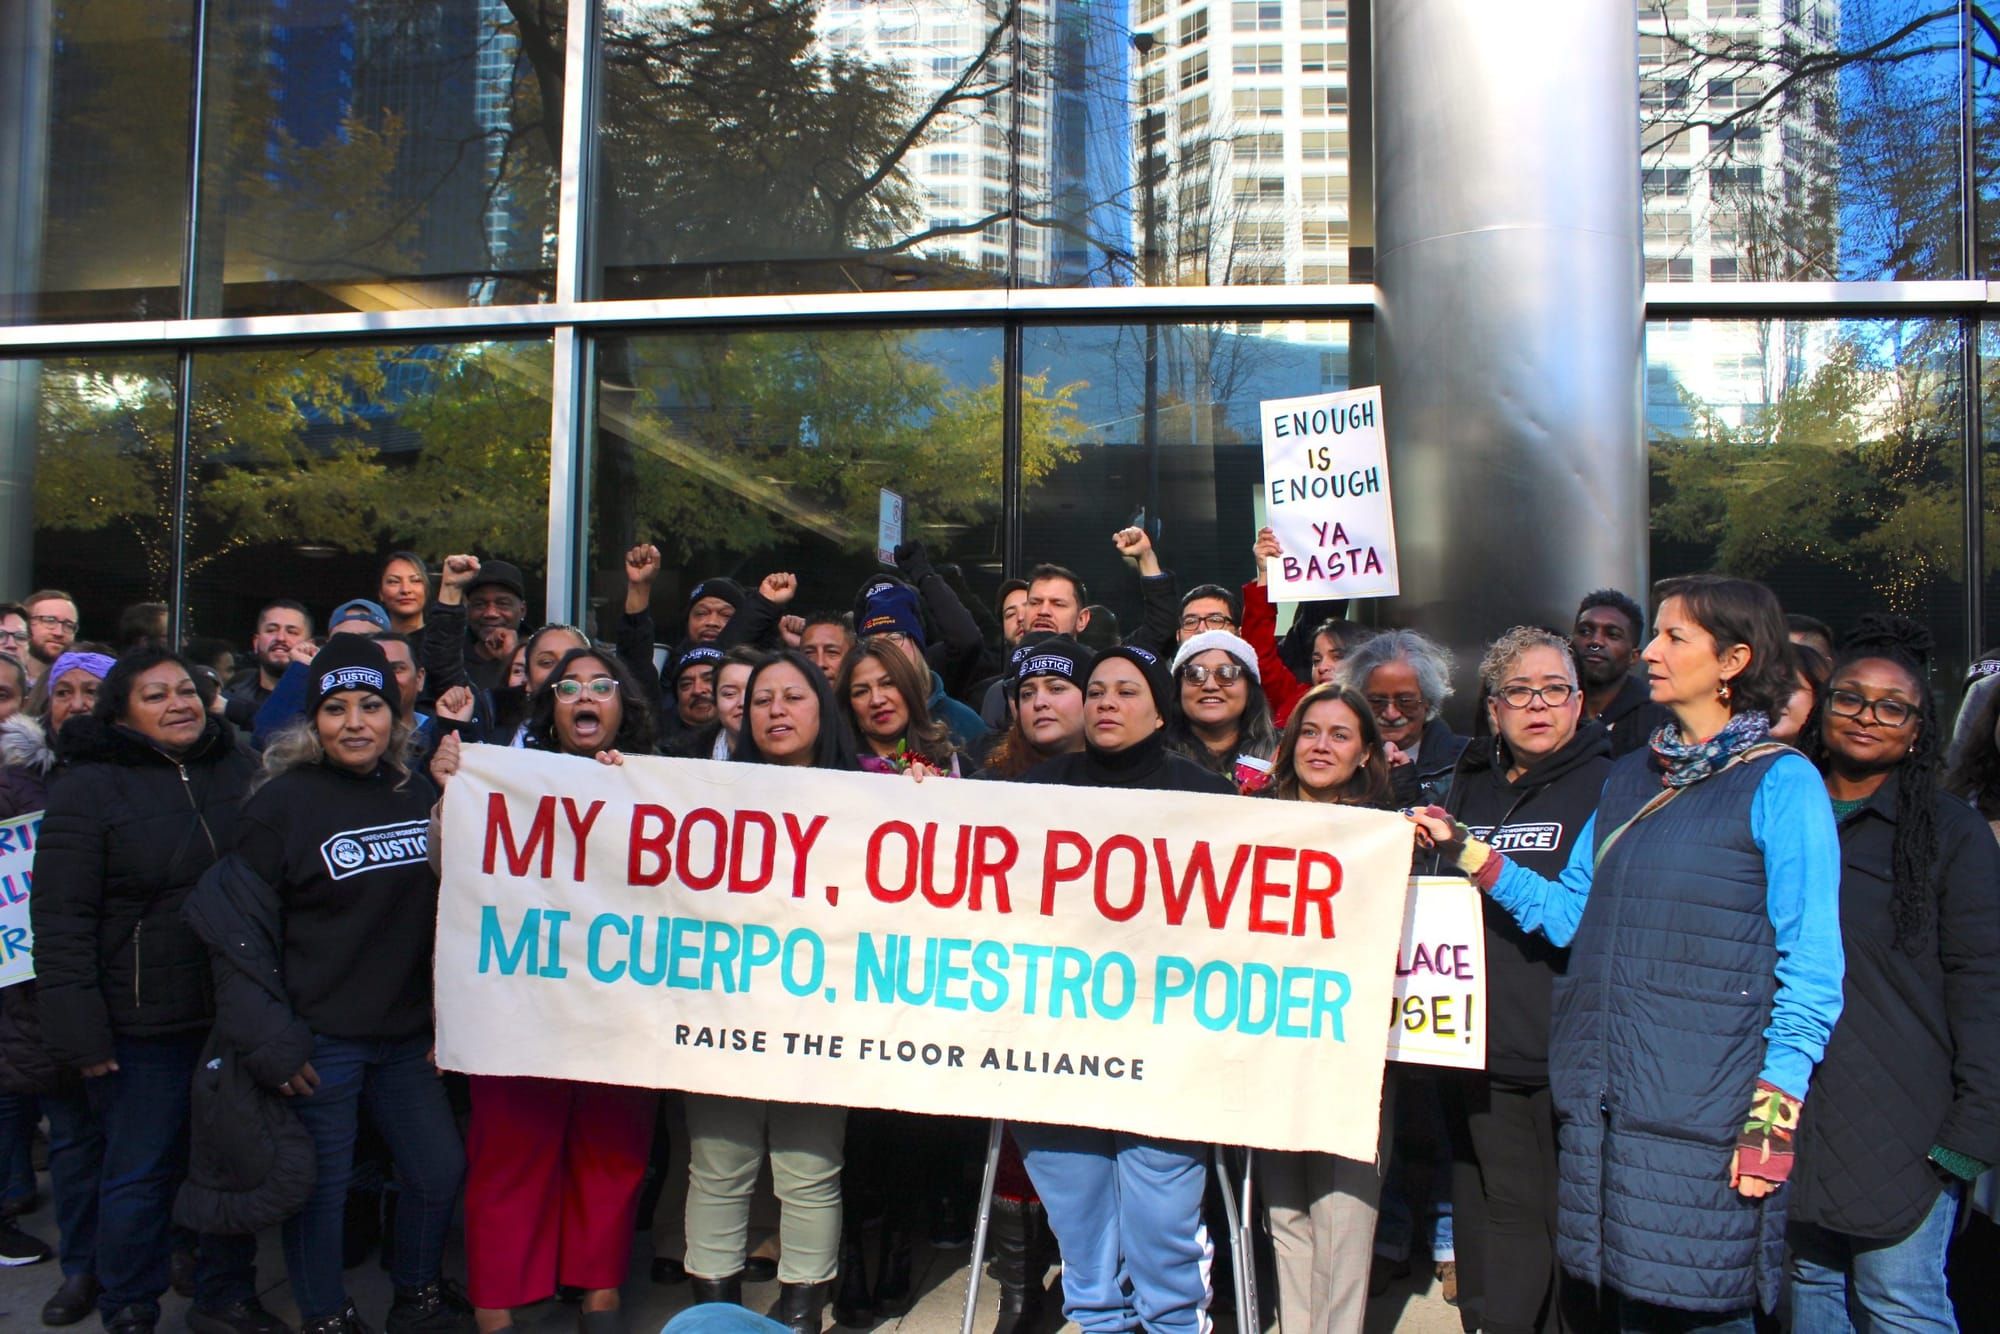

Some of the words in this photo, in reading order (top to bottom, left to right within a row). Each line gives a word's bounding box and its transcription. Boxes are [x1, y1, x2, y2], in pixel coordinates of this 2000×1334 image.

[1274, 400, 1375, 438] ENOUGH
[1308, 447, 1332, 471] IS
[1272, 466, 1380, 505] ENOUGH
[1312, 522, 1350, 547] YA
[1283, 546, 1383, 581] BASTA
[337, 673, 382, 687] JUSTICE
[1029, 660, 1070, 672] JUSTICE
[1475, 832, 1553, 848] STICE
[482, 792, 606, 882] MY
[865, 820, 1019, 913] OUR
[1040, 829, 1344, 938] POWER
[478, 905, 570, 979] MI
[855, 932, 1136, 1020] NUESTRO
[1153, 955, 1352, 1042] PODER
[675, 1024, 766, 1052] RAISE
[783, 1032, 843, 1059] THE
[859, 1038, 965, 1067] FLOOR
[980, 1047, 1145, 1080] ALLIANCE
